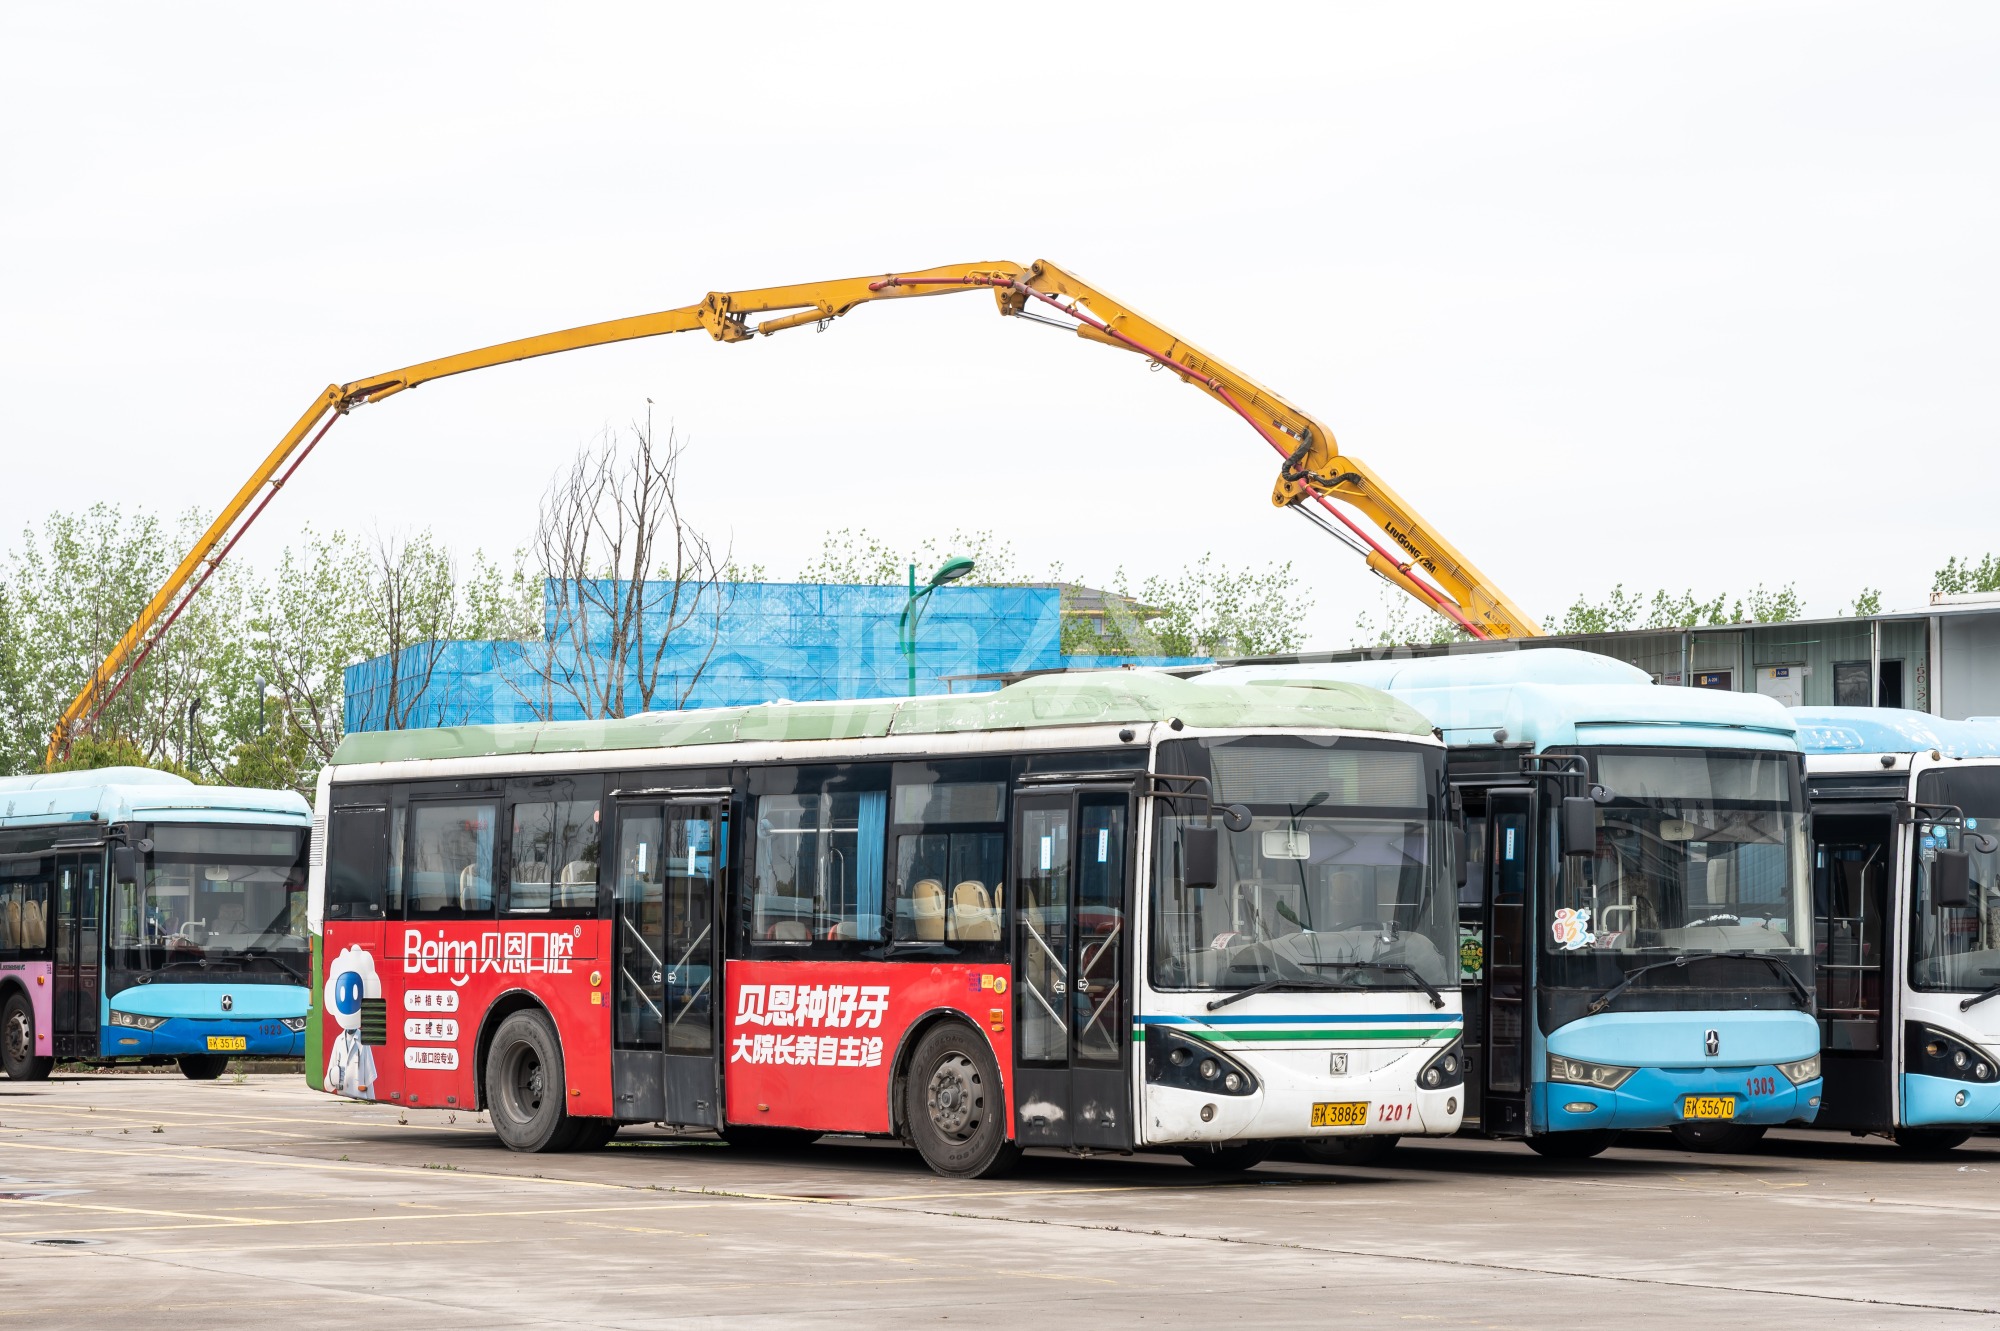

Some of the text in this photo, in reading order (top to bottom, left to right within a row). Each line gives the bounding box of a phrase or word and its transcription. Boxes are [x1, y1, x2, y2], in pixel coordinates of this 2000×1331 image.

[403, 929, 478, 974] Beinn
[479, 932, 574, 974] 贝恩口腔
[414, 994, 454, 1007] 种植专业
[734, 984, 890, 1029] 贝恩种好牙
[259, 1024, 282, 1036] 1923
[414, 1023, 454, 1036] 正畸专业
[414, 1051, 454, 1065] 儿童口腔专业
[730, 1033, 884, 1068] 大院长亲自主诊
[1746, 1077, 1775, 1096] 1303
[1378, 1103, 1413, 1121] 1201
